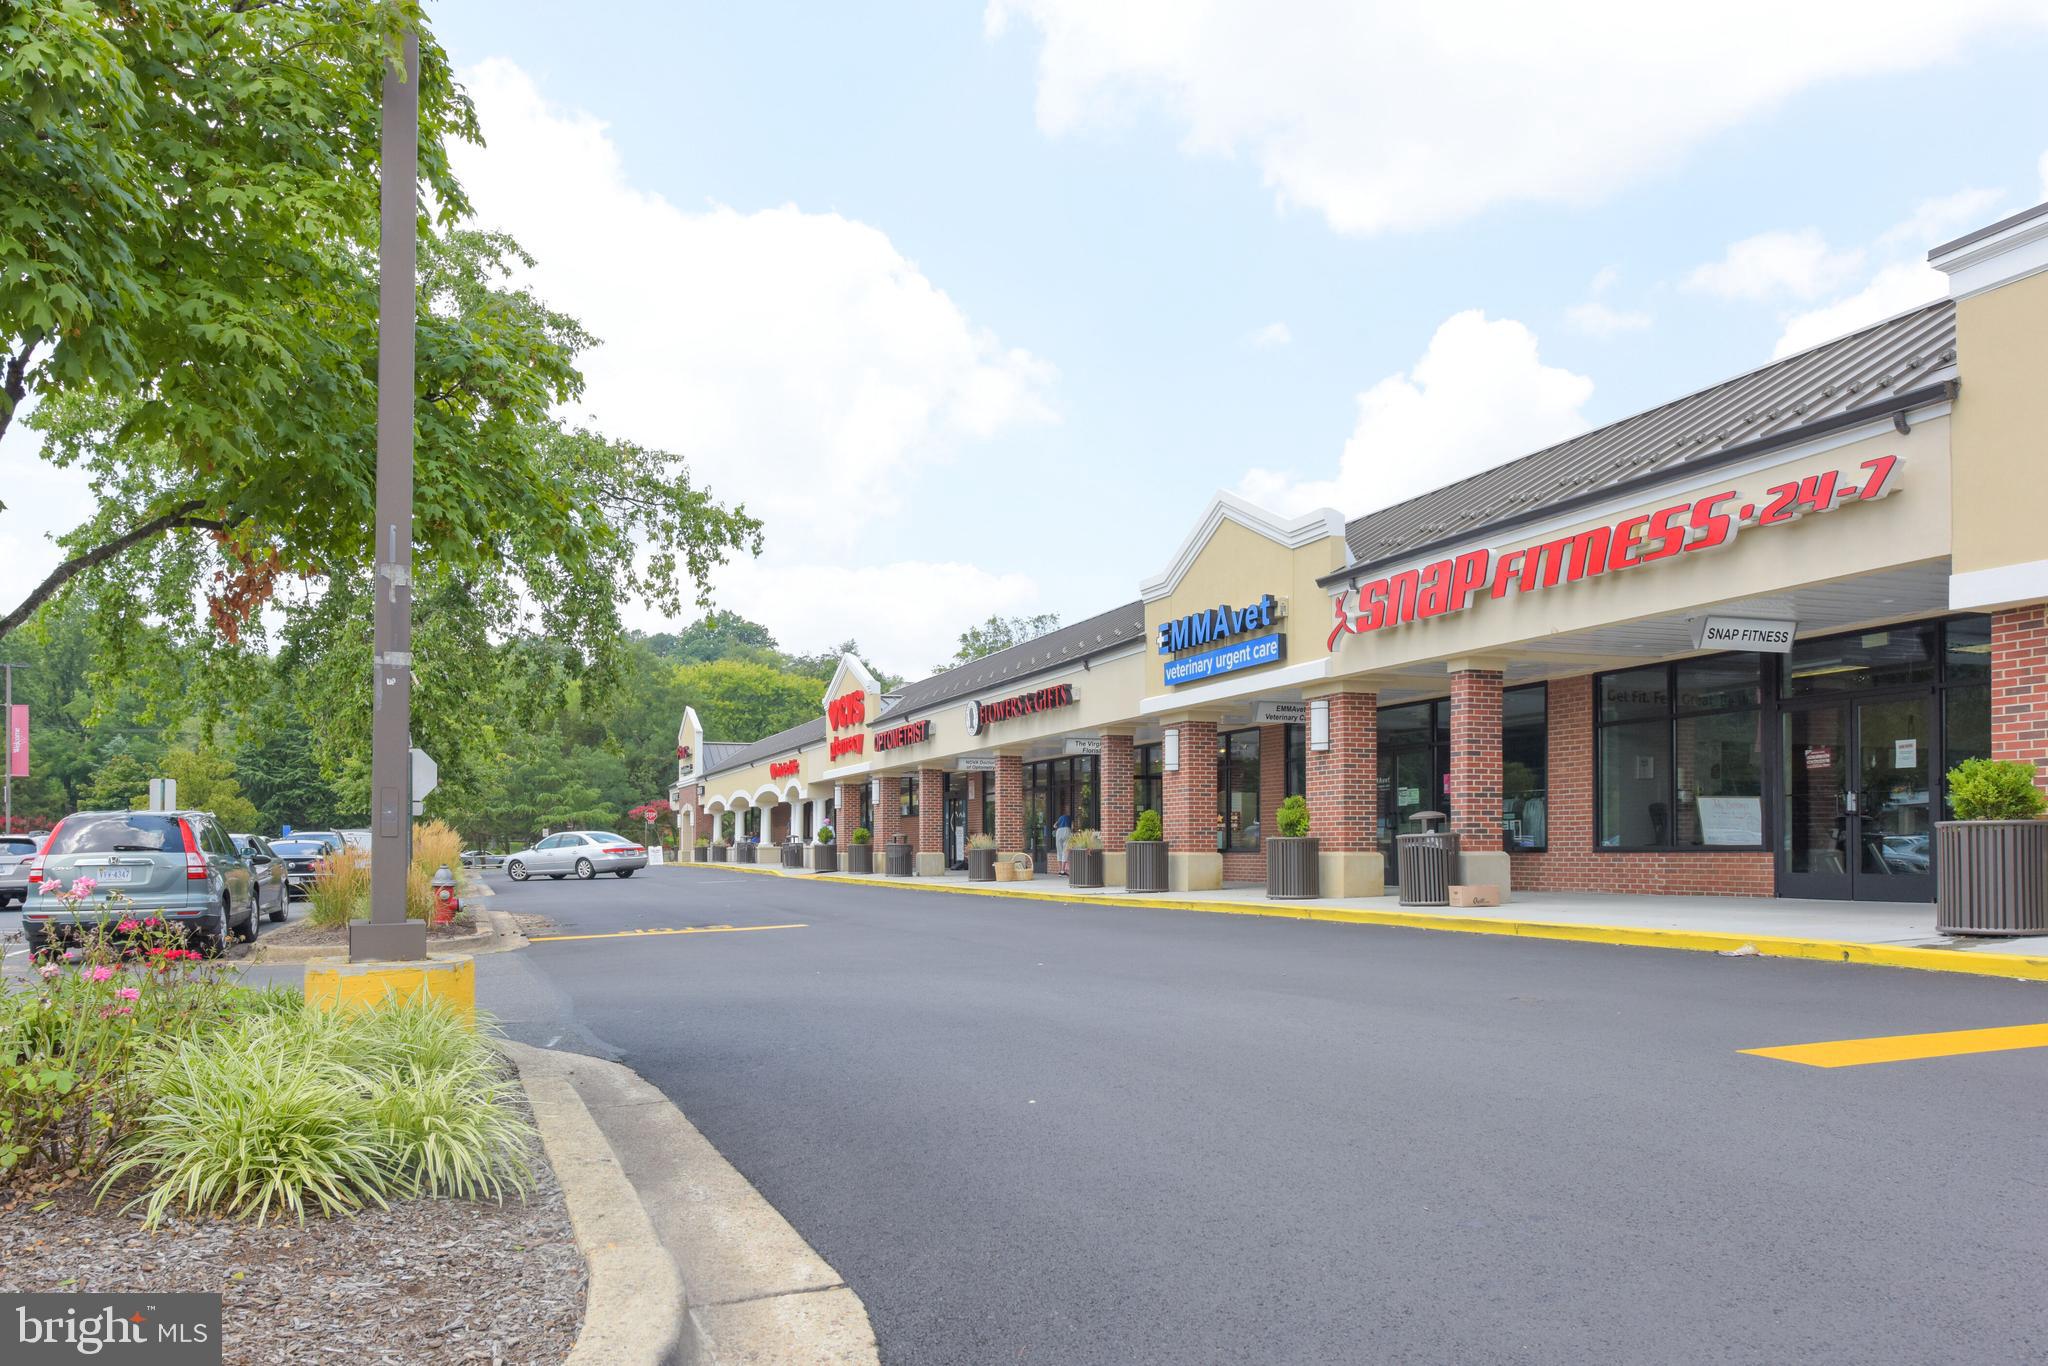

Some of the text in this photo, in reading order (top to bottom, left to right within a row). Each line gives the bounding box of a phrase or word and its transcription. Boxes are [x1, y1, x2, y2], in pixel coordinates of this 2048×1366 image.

[1157, 594, 1276, 656] EMMAvet
[1708, 627, 1789, 643] SNAP FITNESS
[1166, 641, 1279, 681] veterinary urgent care
[980, 697, 1023, 725] FLOWERS
[1024, 692, 1034, 715] &
[1034, 684, 1071, 713] GIFTS
[1264, 713, 1298, 722] Veterinary
[874, 719, 928, 753] OPTOMETRIST
